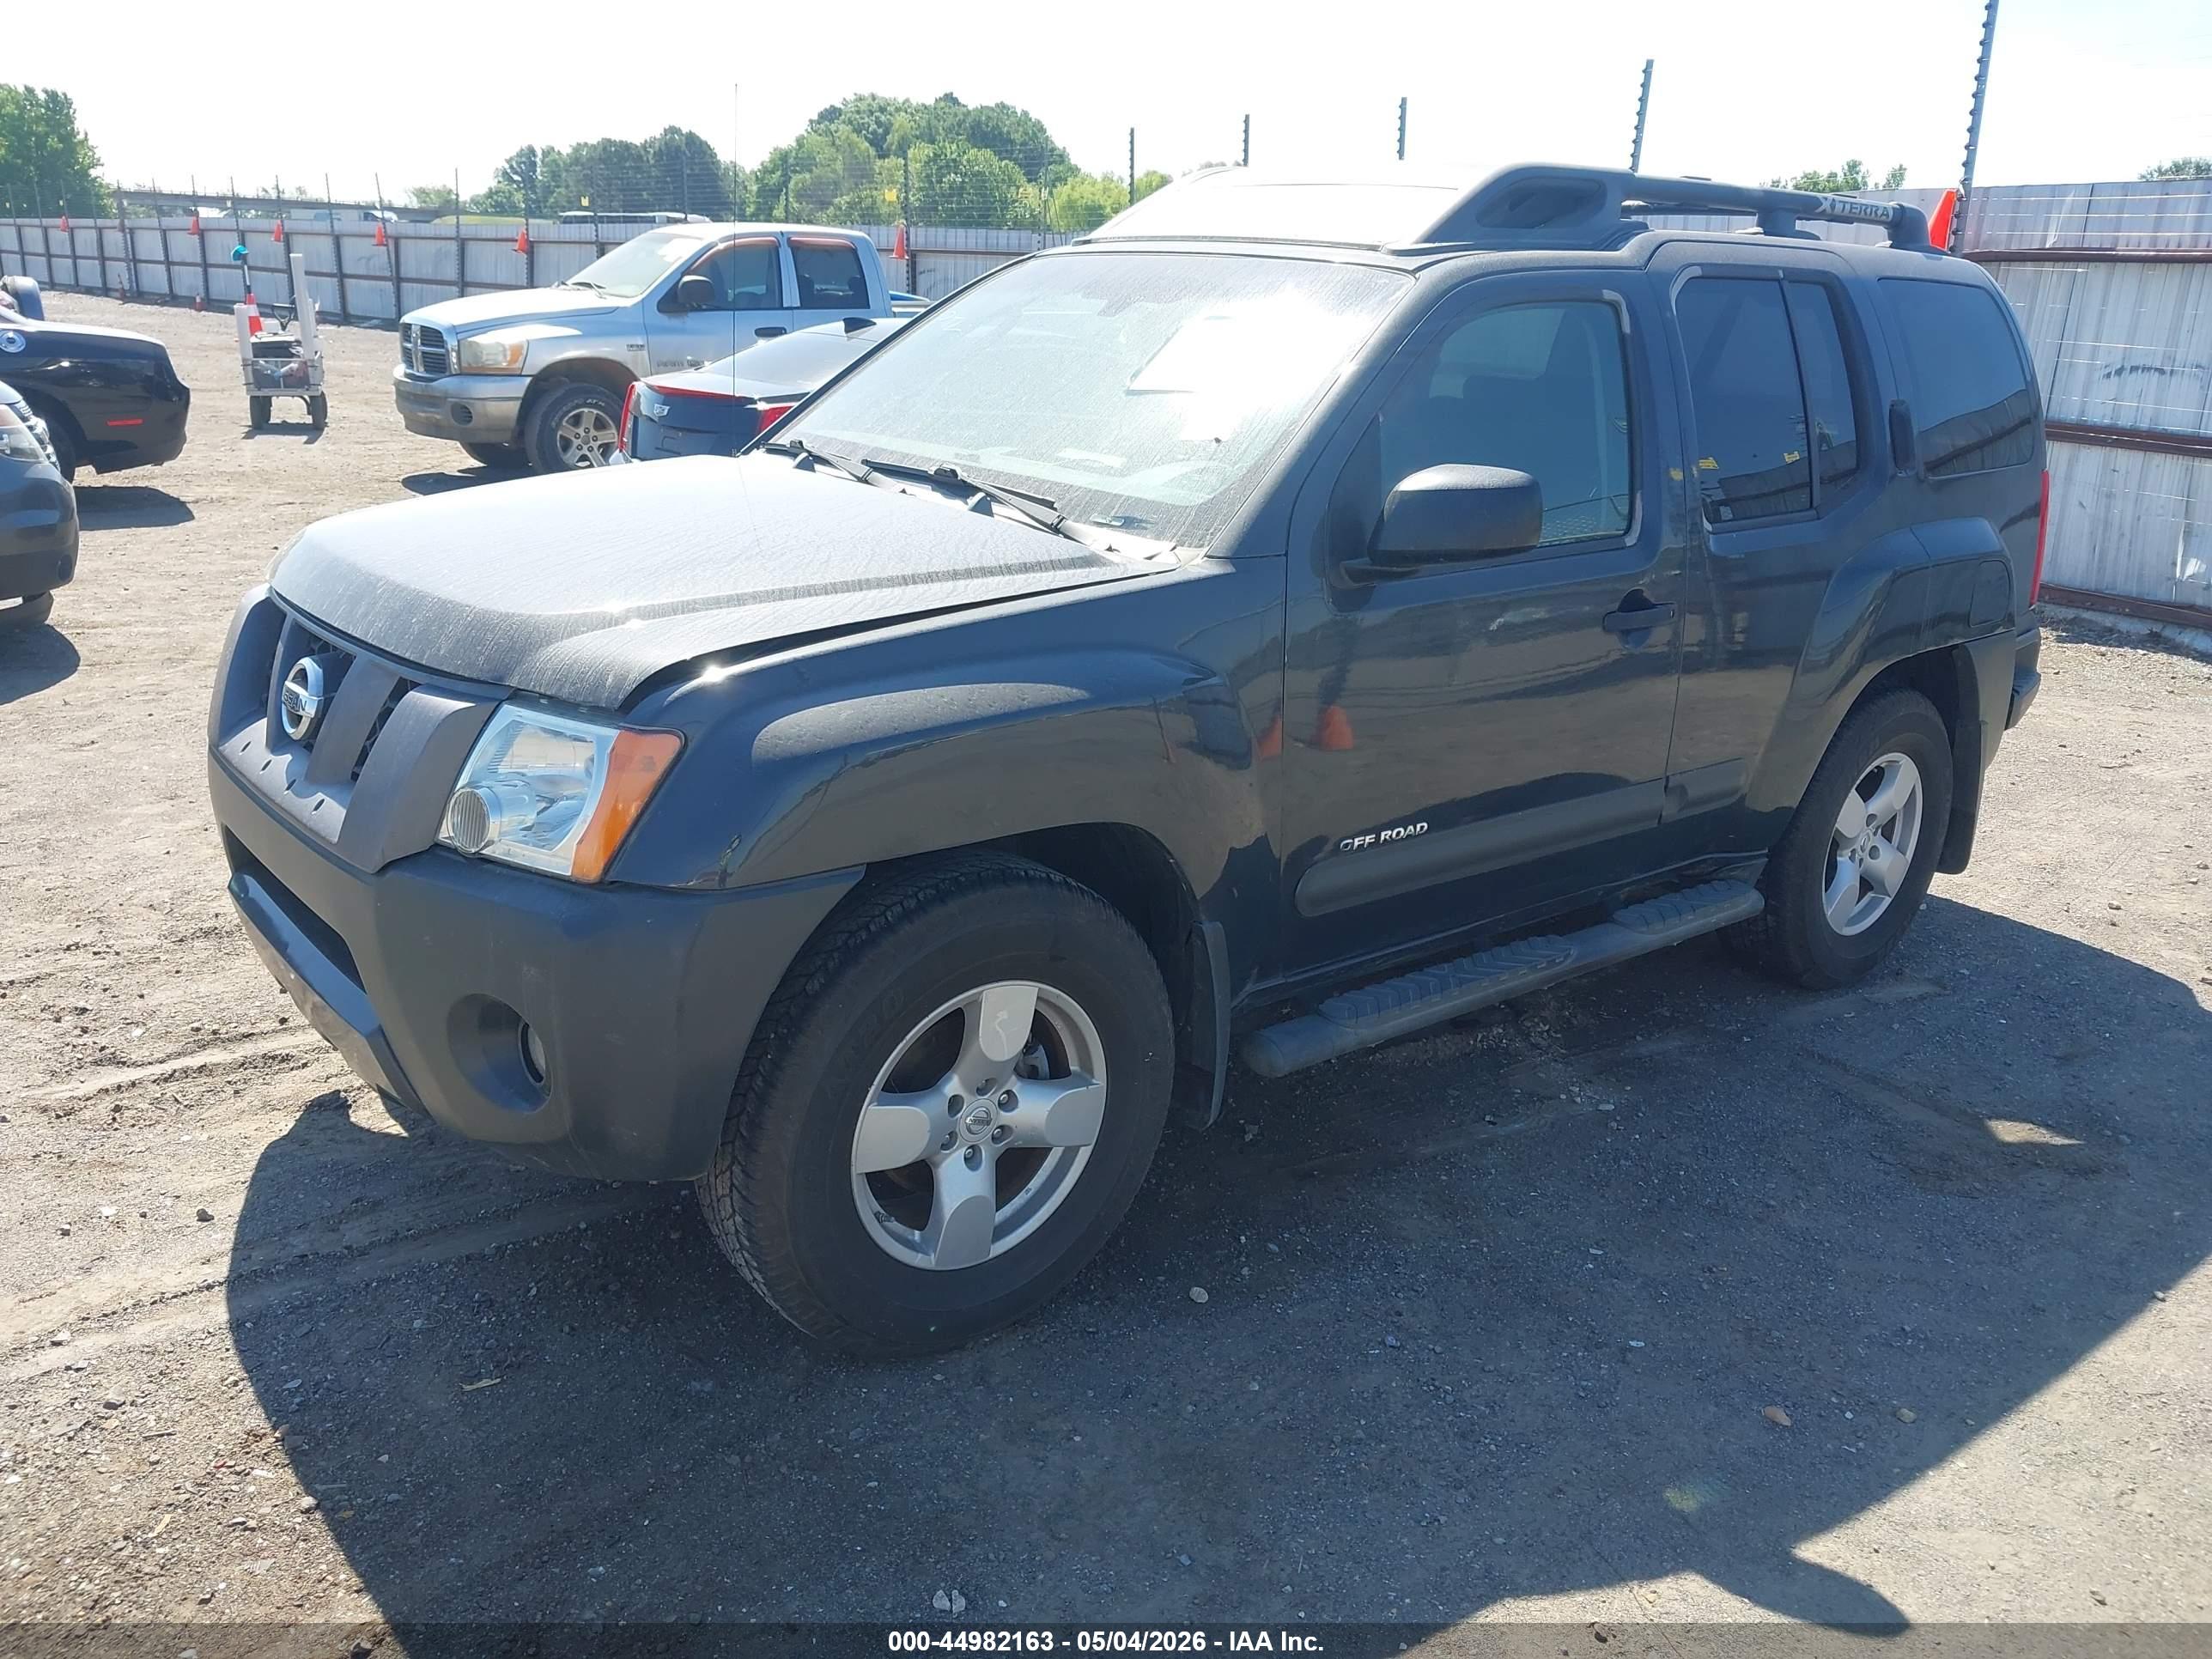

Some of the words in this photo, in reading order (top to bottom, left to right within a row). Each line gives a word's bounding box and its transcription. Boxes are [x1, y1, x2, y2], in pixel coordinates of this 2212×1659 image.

[1814, 195, 1891, 220] XTERRA
[283, 690, 307, 712] SSAN
[1340, 833, 1376, 851] OFF
[1380, 822, 1429, 844] ROAD
